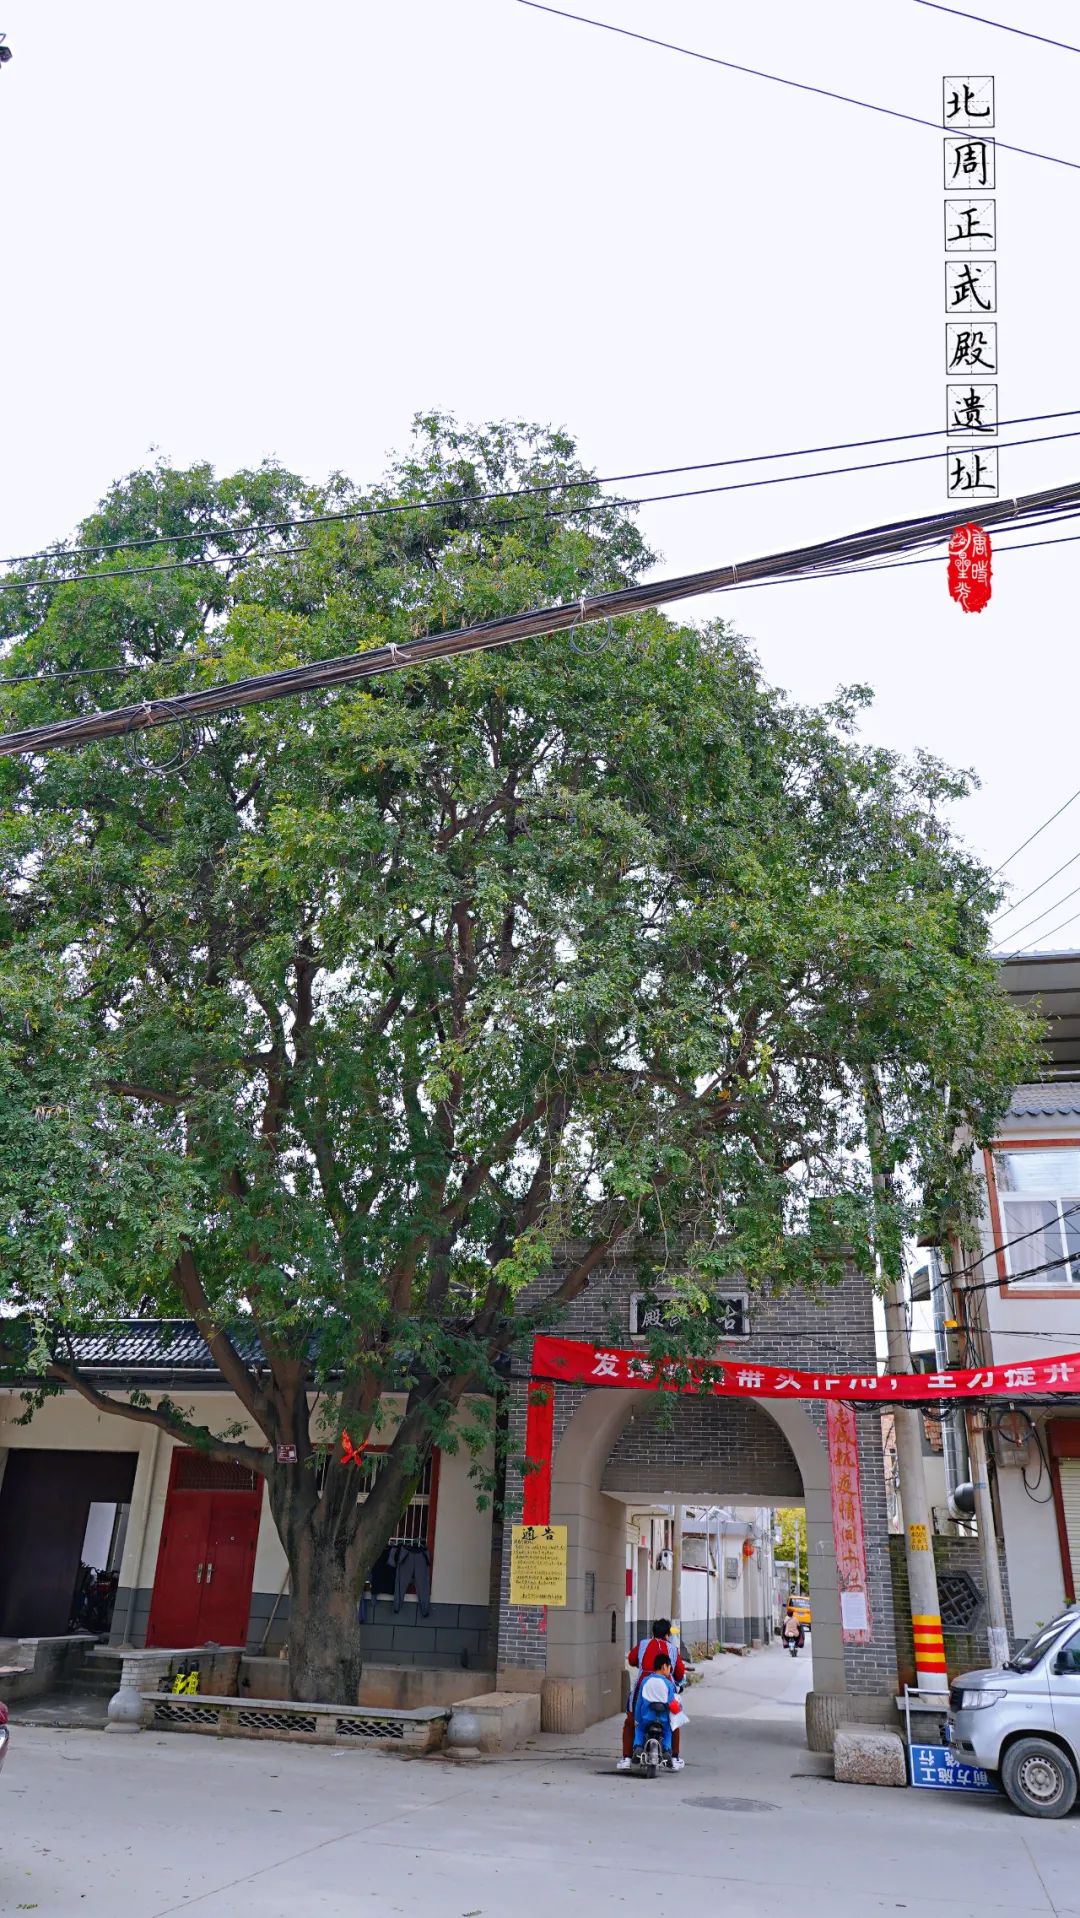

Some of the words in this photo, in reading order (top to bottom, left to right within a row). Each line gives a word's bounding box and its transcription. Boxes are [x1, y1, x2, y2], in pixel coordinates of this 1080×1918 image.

[522, 1526, 556, 1541] 通告
[919, 1767, 989, 1787] 前方施工
